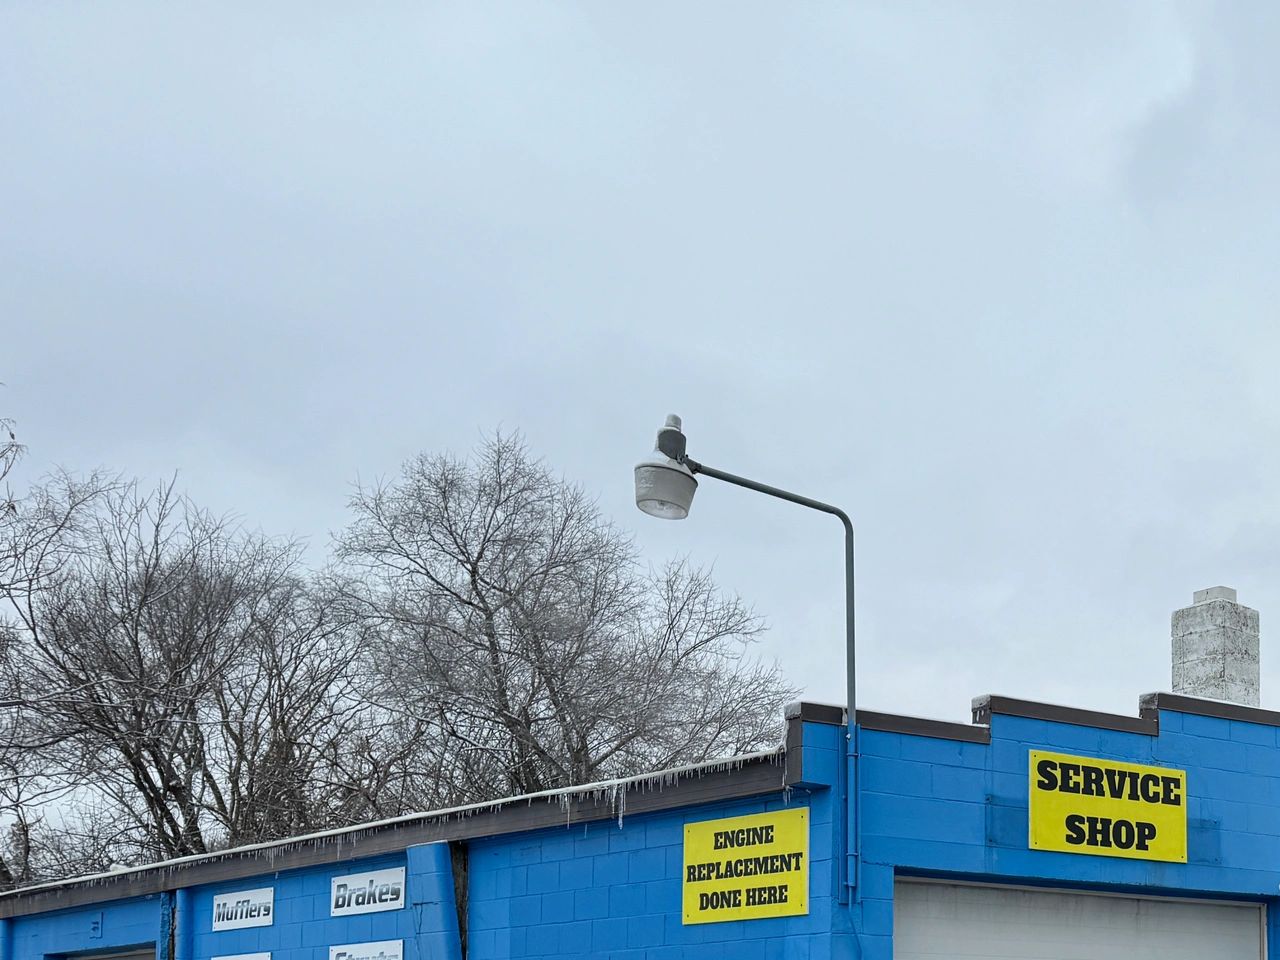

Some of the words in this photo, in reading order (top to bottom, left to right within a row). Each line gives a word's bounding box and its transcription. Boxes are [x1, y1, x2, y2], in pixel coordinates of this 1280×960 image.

[1037, 759, 1181, 806] SERVICE
[713, 825, 774, 850] ENGINE
[1065, 814, 1157, 851] SHOP
[686, 852, 803, 883] REPLACEMENT
[334, 880, 402, 909] Brakes
[699, 889, 742, 911] DONE
[745, 884, 788, 906] HERE
[214, 899, 271, 923] Mufflers
